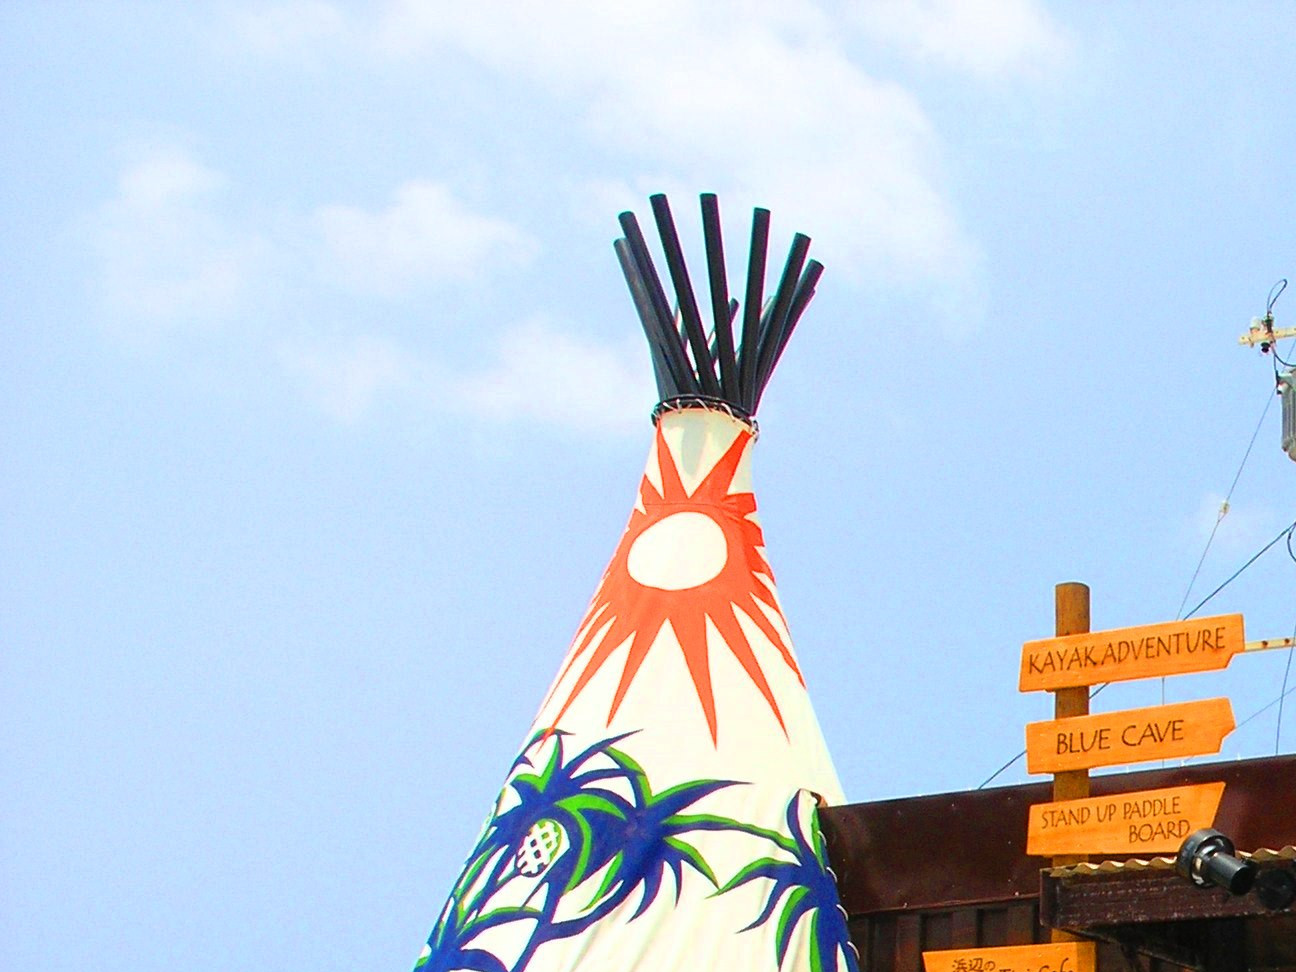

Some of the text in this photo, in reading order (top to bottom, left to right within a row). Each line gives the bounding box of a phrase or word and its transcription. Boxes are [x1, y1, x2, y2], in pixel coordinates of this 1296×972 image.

[1028, 626, 1226, 675] KAYAK ADVENTURE
[1056, 719, 1185, 755] BLUE CAVE
[1041, 796, 1182, 830] STAND UP PADDLE
[1128, 820, 1191, 845] BOARD
